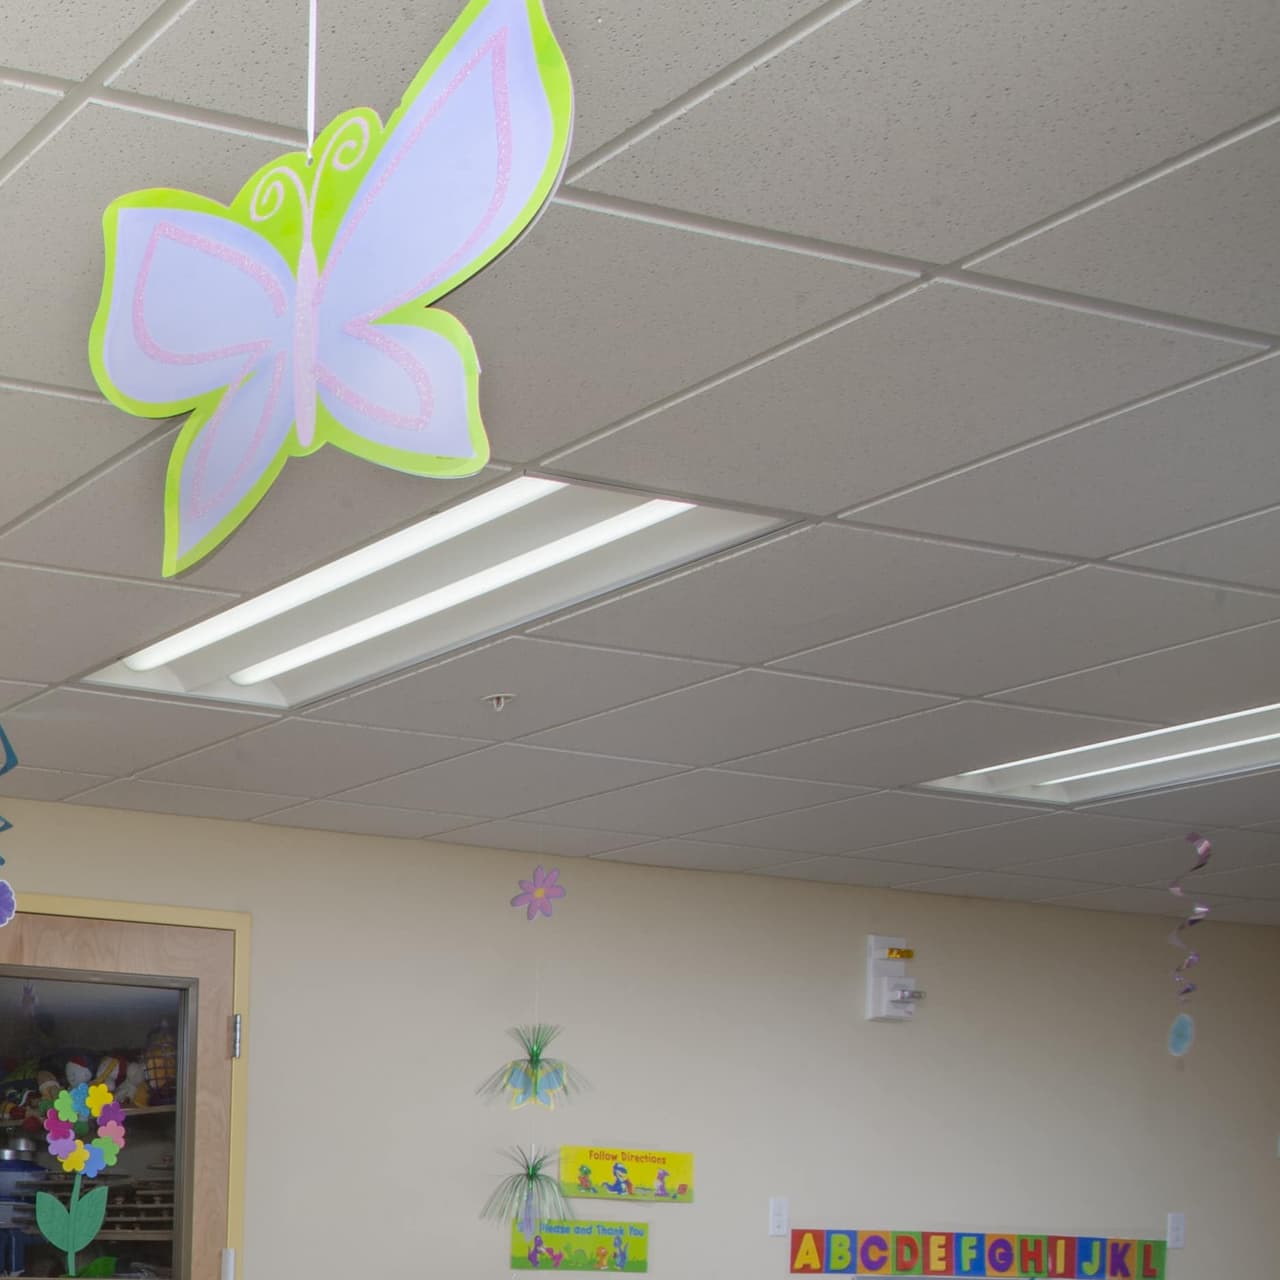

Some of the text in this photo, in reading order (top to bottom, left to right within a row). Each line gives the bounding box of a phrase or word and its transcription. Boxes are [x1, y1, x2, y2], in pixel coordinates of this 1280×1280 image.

[588, 1150, 667, 1165] Follow Directions
[574, 1224, 593, 1235] and
[596, 1224, 625, 1236] Thank
[629, 1225, 645, 1237] You
